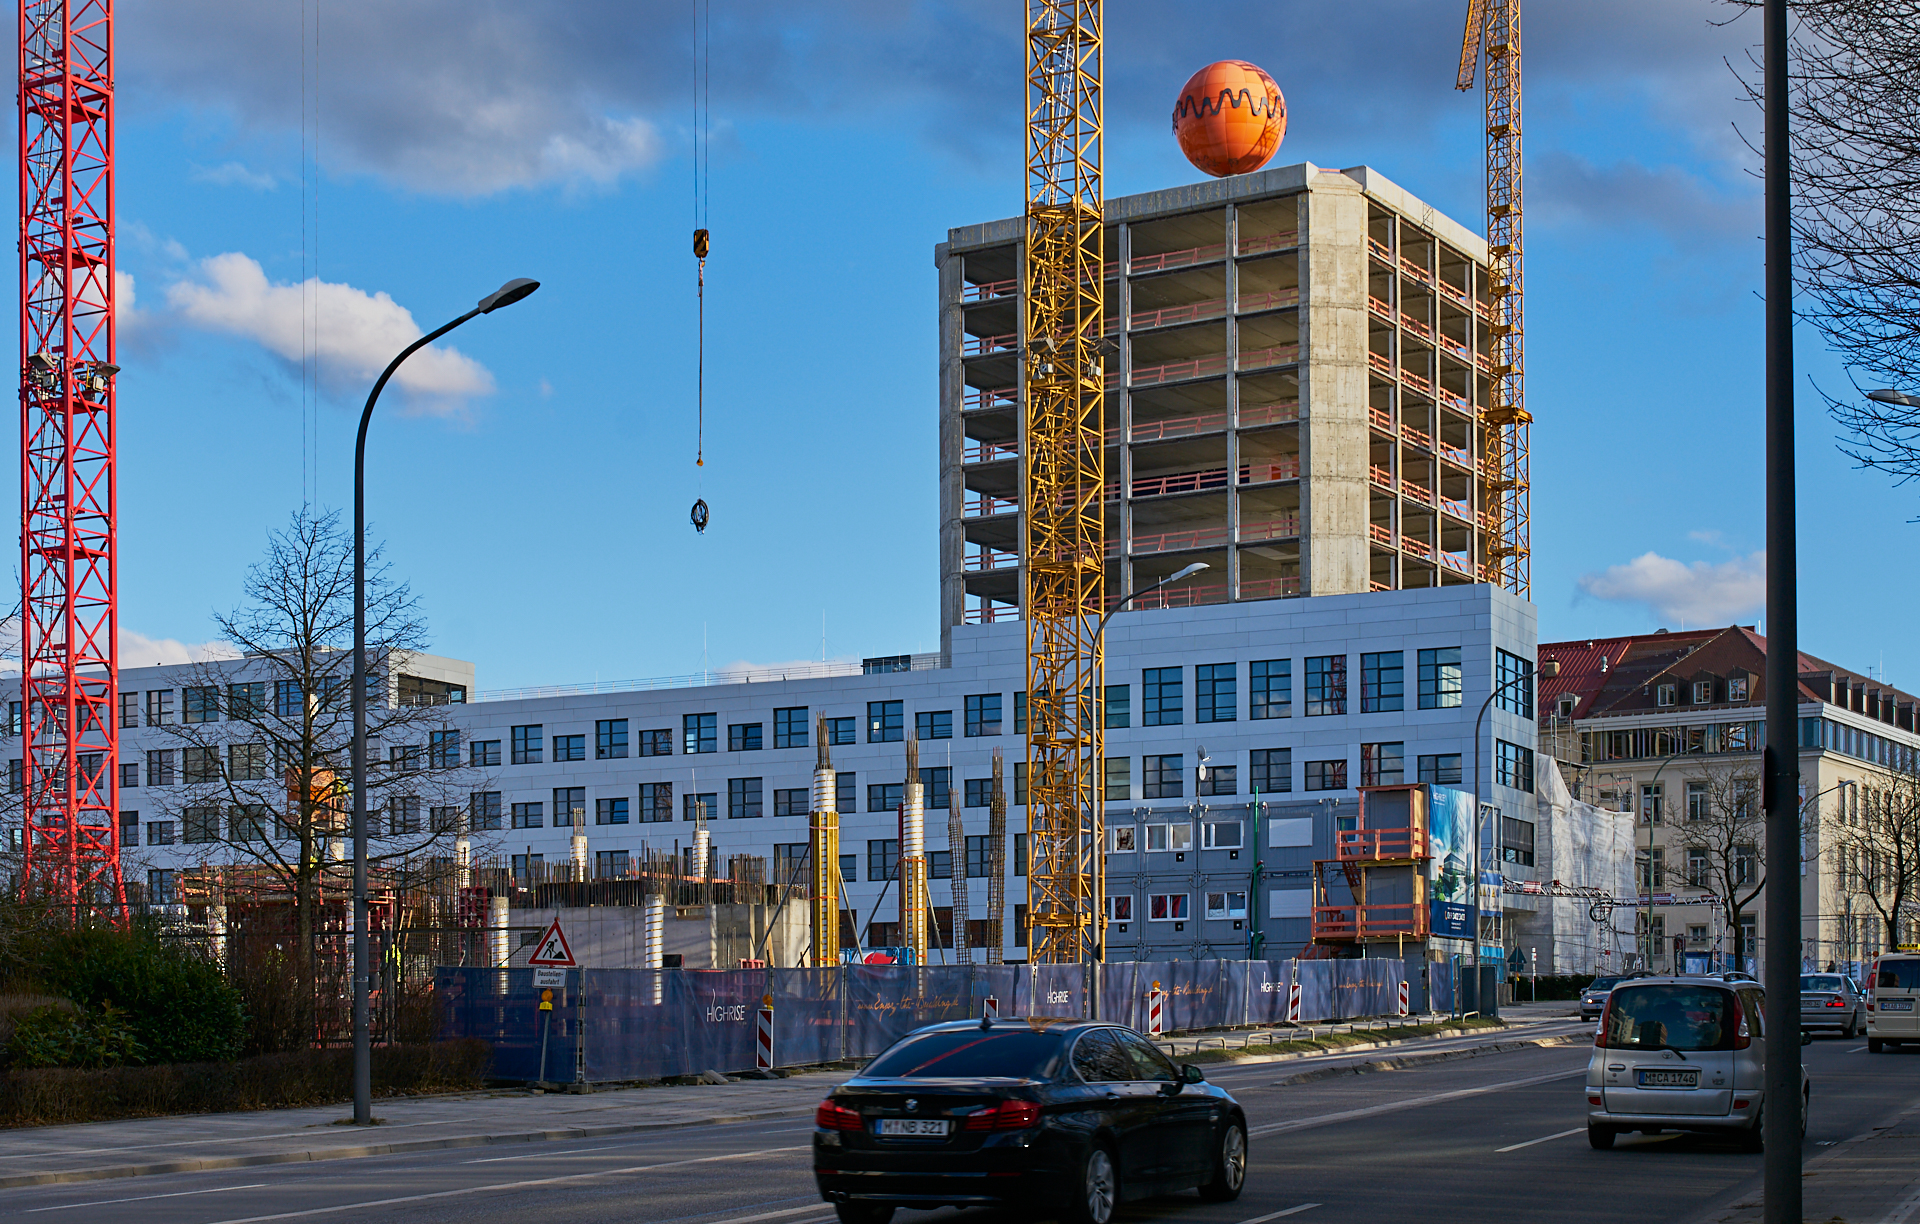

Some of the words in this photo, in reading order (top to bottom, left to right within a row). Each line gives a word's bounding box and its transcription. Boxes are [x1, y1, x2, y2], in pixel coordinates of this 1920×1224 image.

[537, 969, 564, 977] Baustellen-
[540, 978, 560, 986] ausfahrt
[706, 988, 746, 1022] HIGHRISE
[1656, 1073, 1669, 1083] CA
[1671, 1073, 1695, 1083] 1746
[902, 1120, 918, 1134] NB
[920, 1120, 943, 1135] 321
